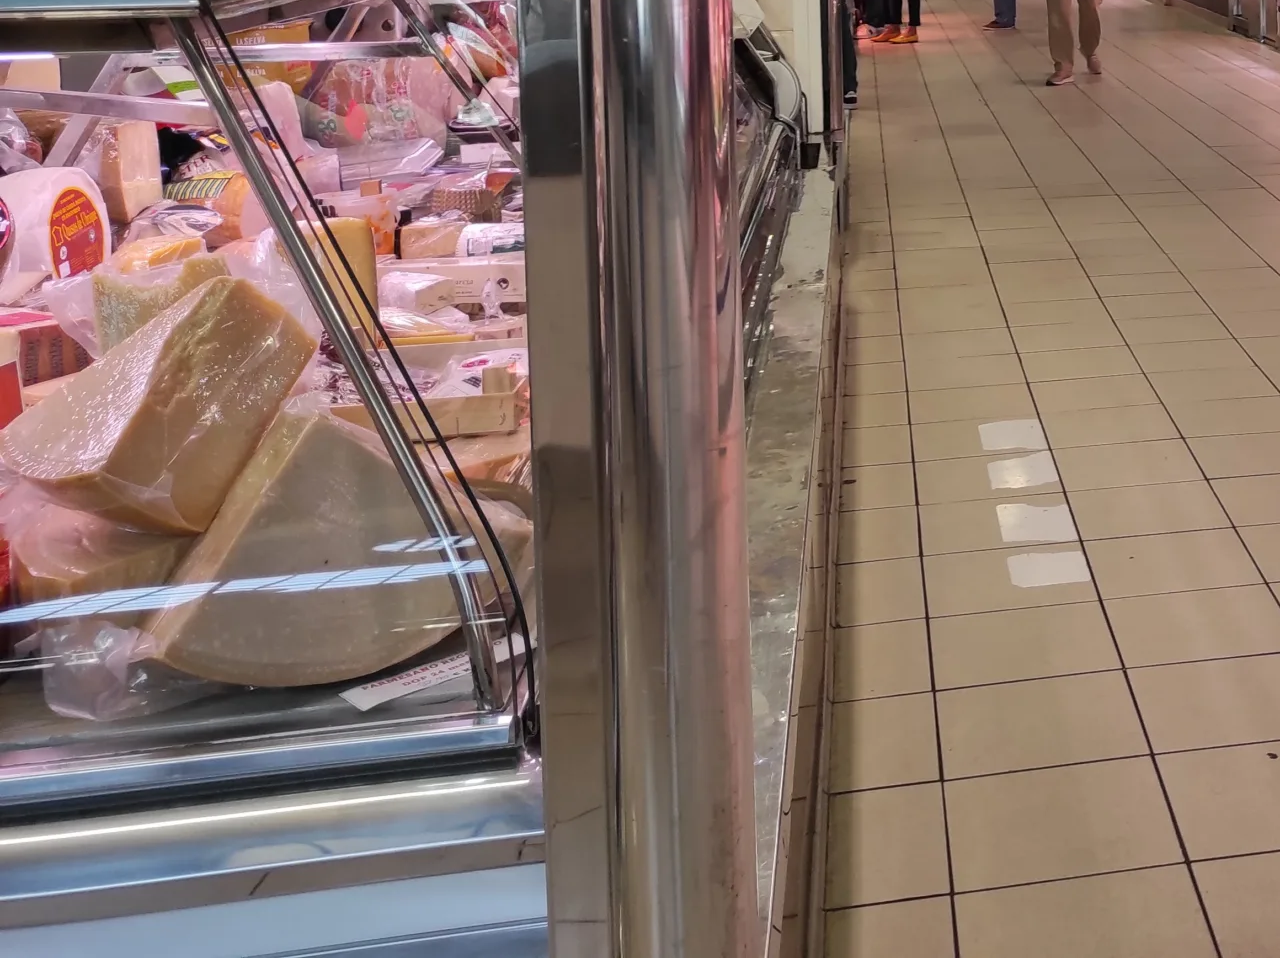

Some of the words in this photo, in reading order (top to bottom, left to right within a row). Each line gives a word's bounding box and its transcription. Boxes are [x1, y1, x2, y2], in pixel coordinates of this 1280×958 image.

[243, 36, 266, 45] SELVA
[360, 663, 439, 692] PARMESANO
[402, 675, 428, 687] DOP
[431, 669, 446, 677] 24
